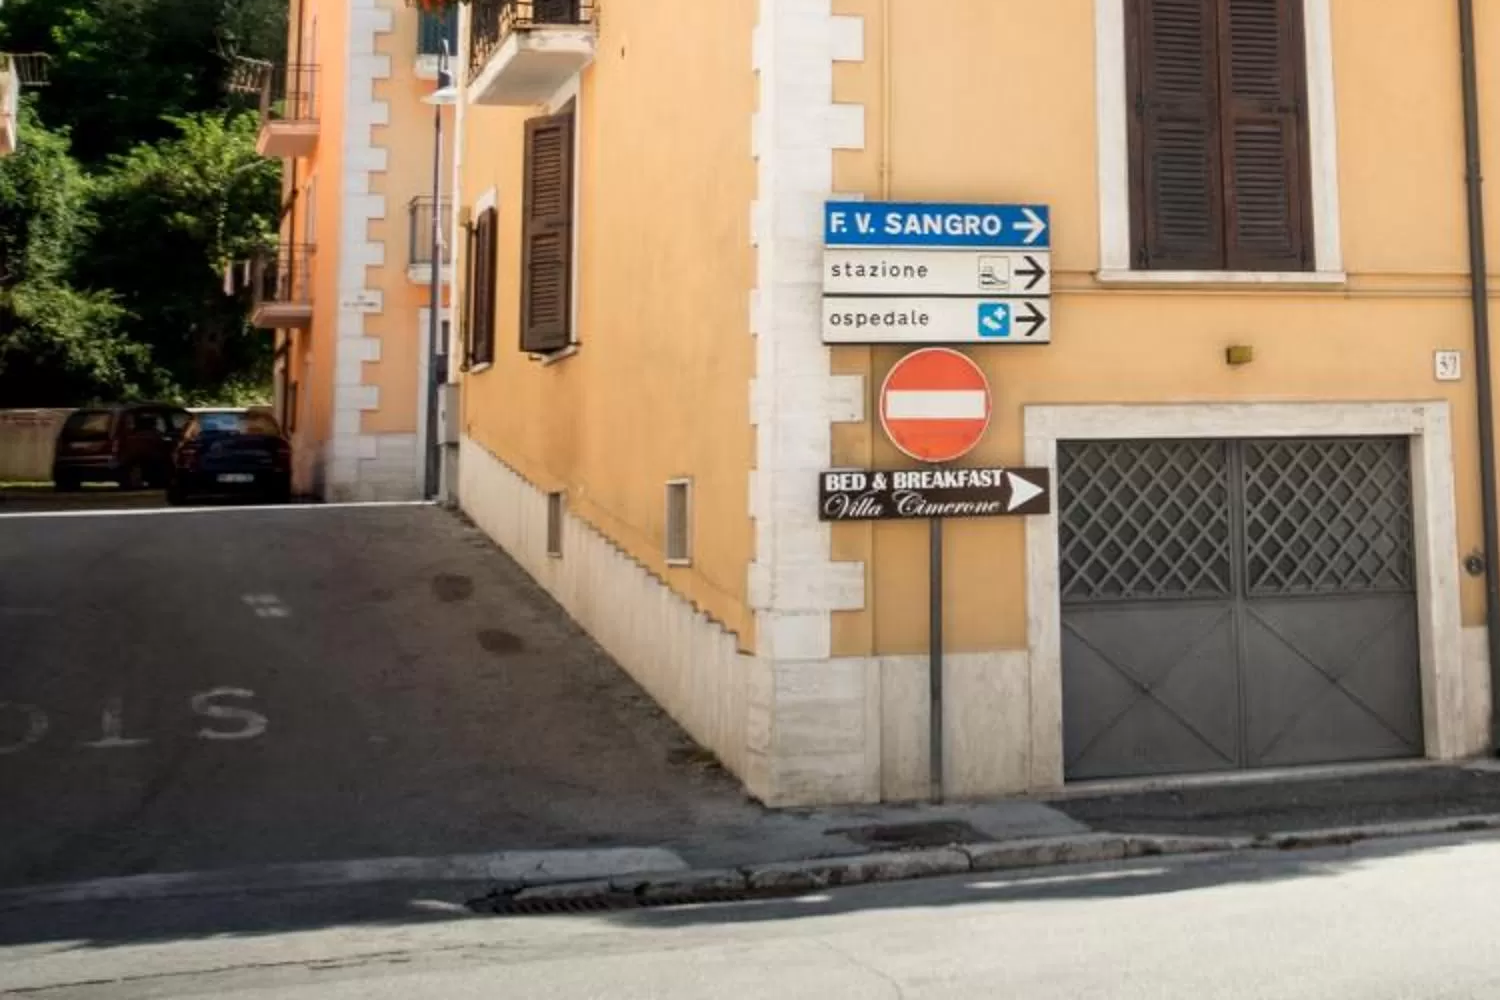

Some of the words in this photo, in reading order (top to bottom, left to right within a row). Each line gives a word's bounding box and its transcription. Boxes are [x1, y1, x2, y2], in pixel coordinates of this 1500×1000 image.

[830, 212, 847, 234] F.
[855, 212, 875, 235] V.
[884, 212, 1002, 236] SANGRO
[831, 261, 928, 278] stazione
[829, 309, 929, 328] ospedale
[825, 473, 867, 491] BED
[871, 471, 887, 490] &
[892, 469, 1003, 489] BREAKFAST
[823, 489, 884, 519] Villa
